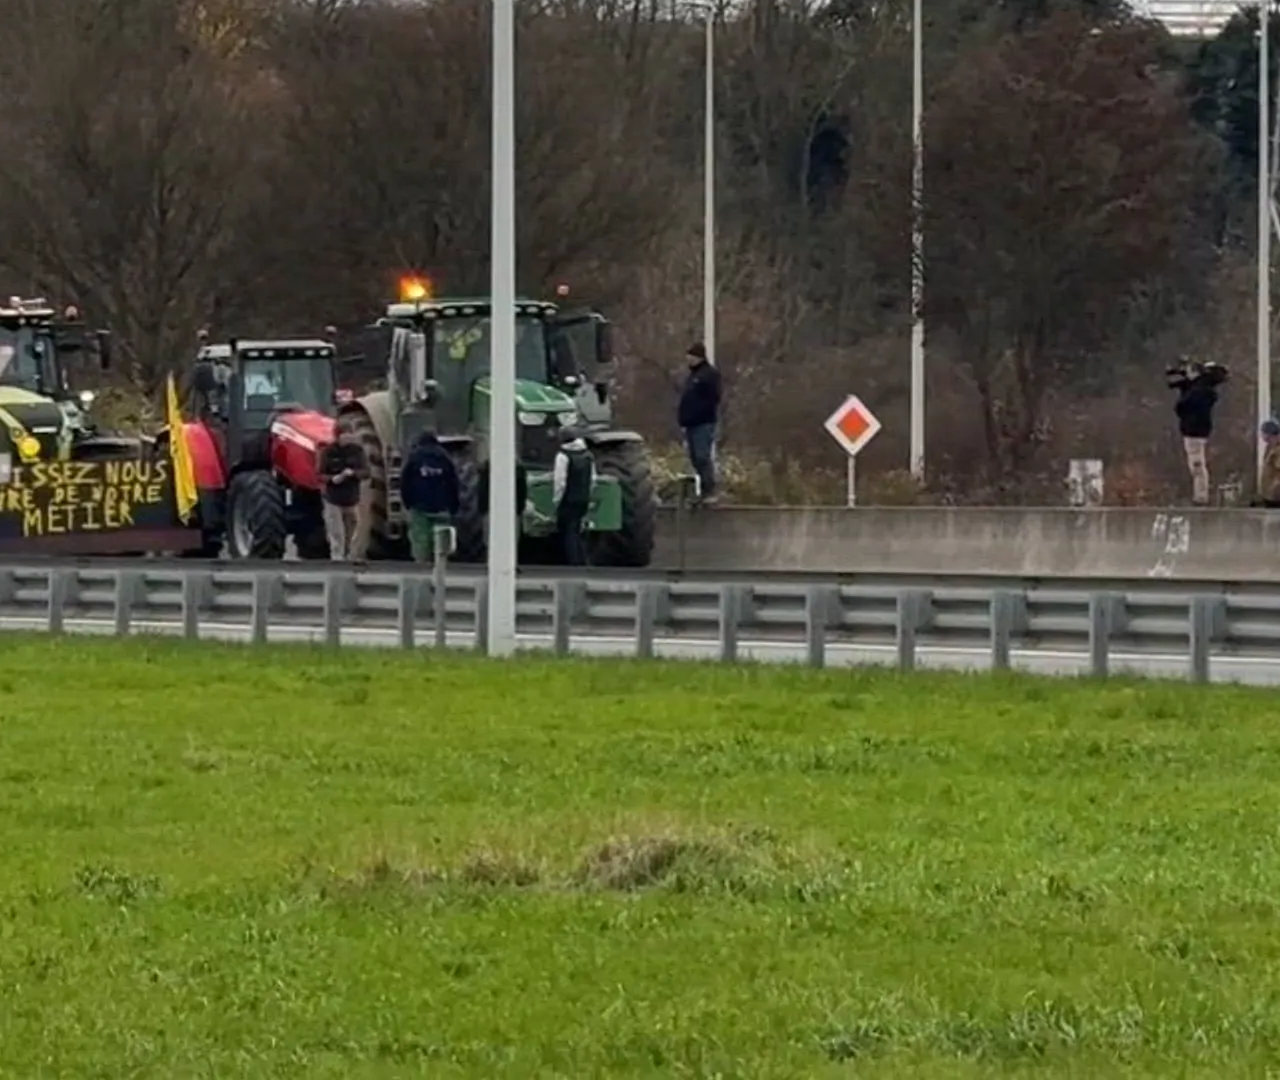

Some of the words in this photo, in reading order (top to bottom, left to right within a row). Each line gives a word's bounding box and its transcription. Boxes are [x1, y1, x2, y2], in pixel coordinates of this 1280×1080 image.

[105, 460, 168, 484] NOUS
[55, 485, 81, 504] DE
[91, 483, 163, 503] NOTRE
